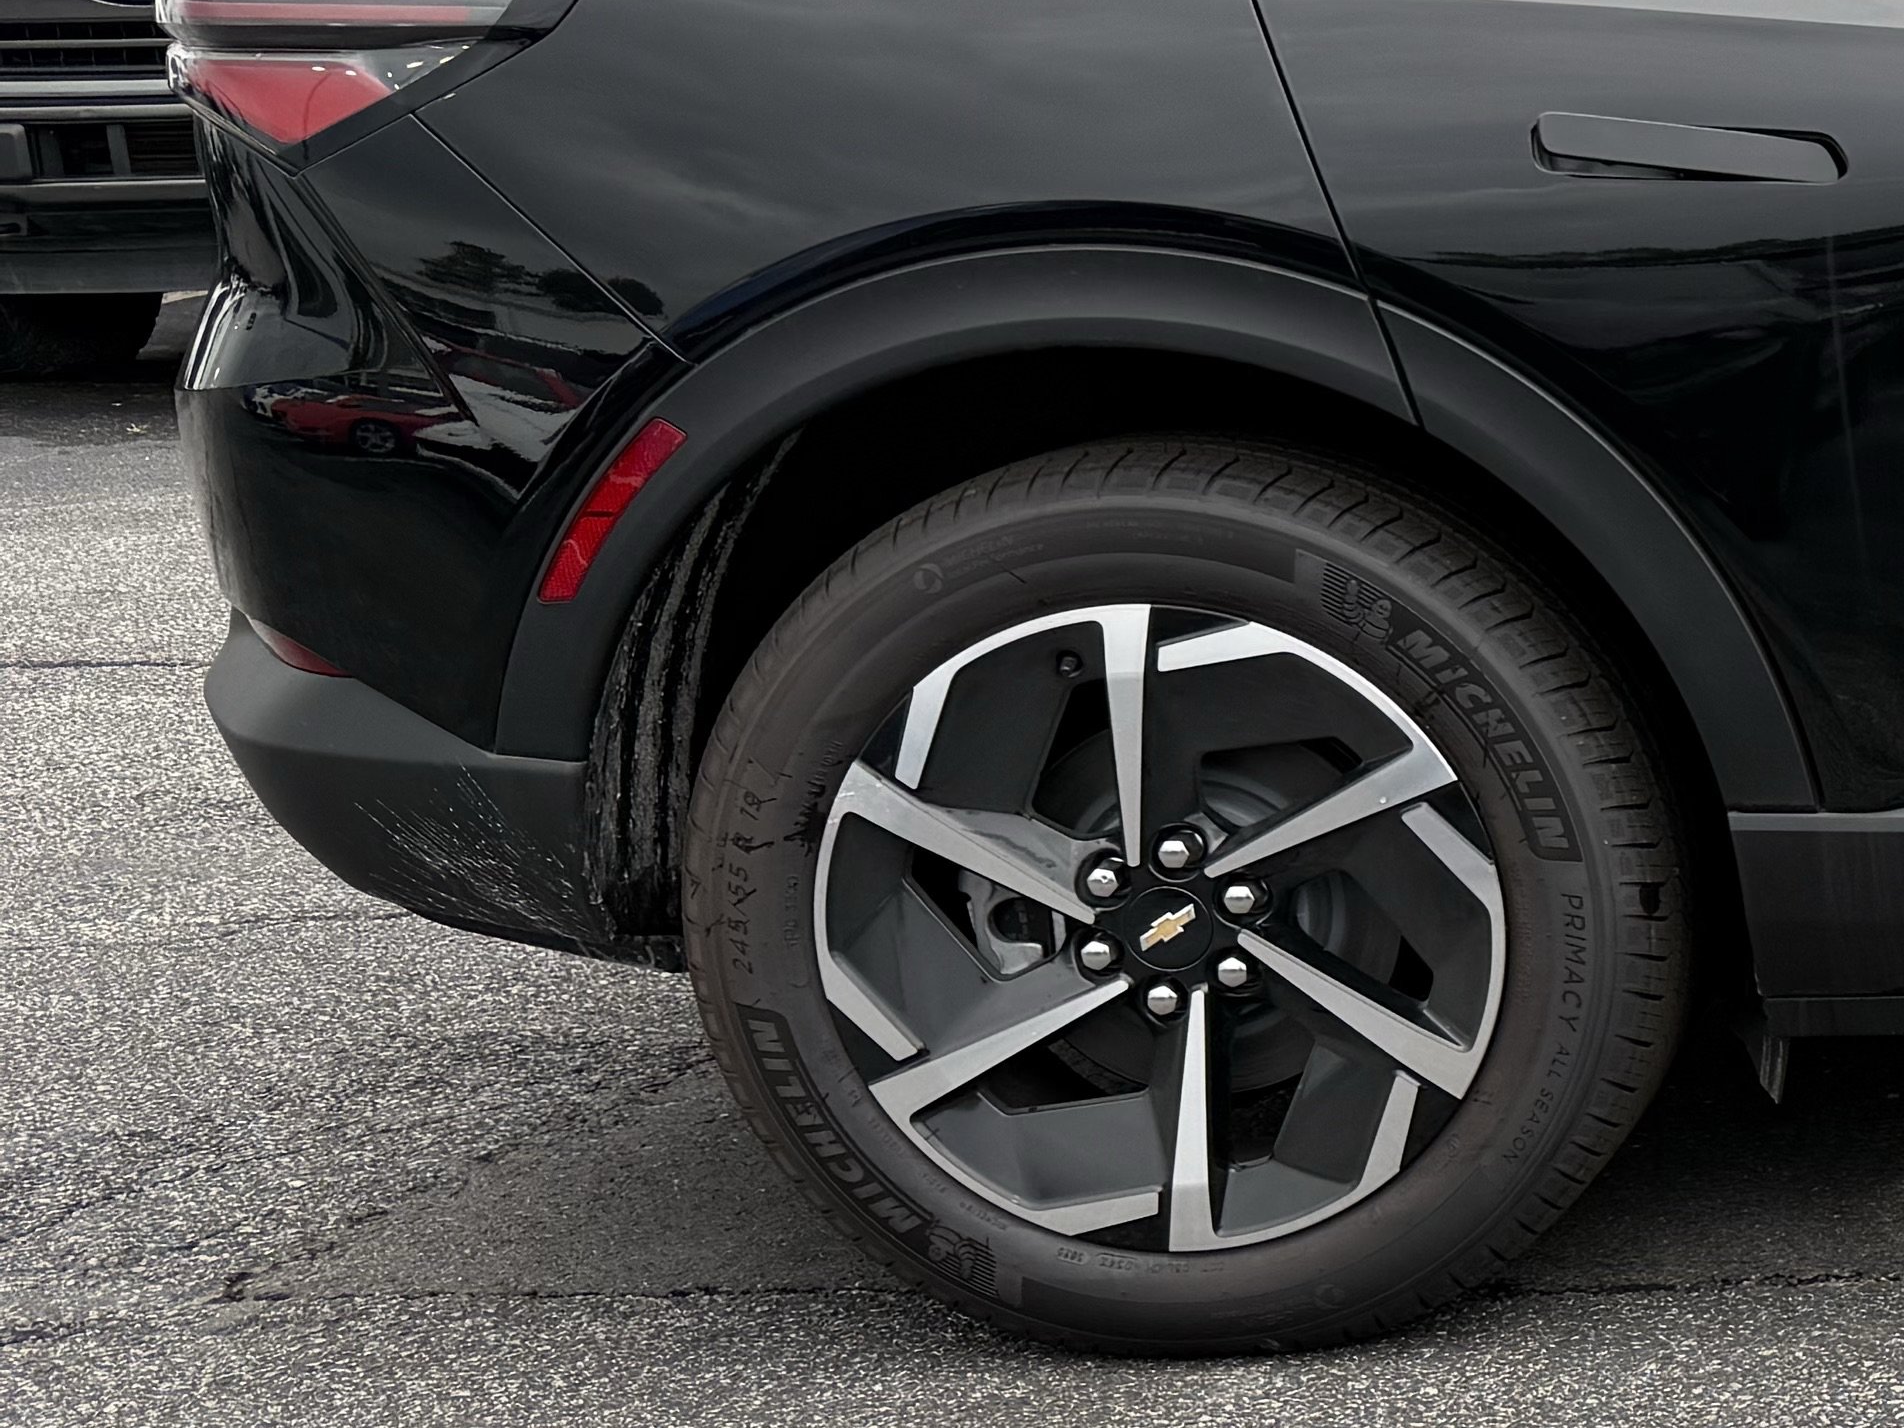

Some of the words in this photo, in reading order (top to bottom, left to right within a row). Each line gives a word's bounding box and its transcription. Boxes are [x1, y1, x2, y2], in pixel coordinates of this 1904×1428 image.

[1397, 628, 1571, 850] MICHELIN
[728, 864, 753, 975] 245/55
[1557, 892, 1587, 1033] PRIMACY
[1545, 1042, 1571, 1079] ALL
[747, 1019, 923, 1234] MICHELIN
[1502, 1087, 1554, 1165] SEASON
